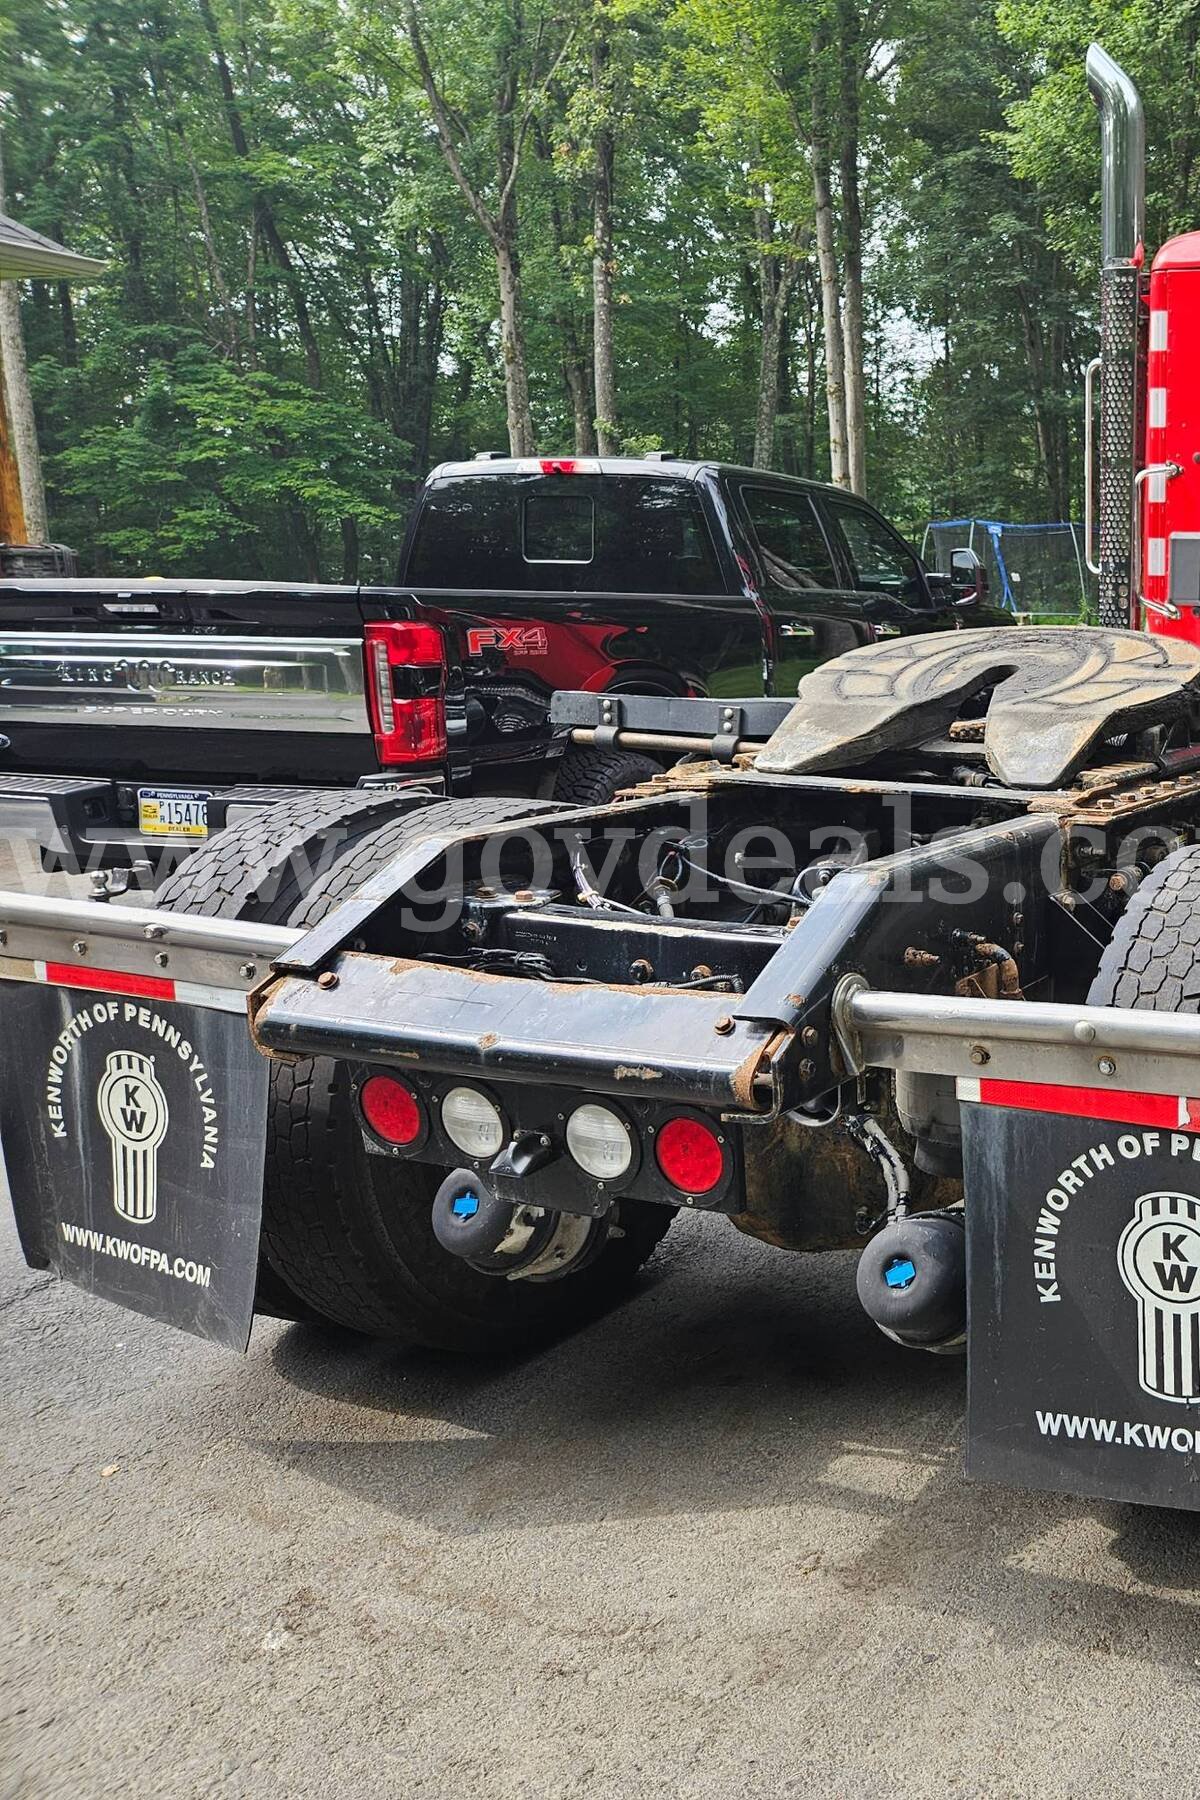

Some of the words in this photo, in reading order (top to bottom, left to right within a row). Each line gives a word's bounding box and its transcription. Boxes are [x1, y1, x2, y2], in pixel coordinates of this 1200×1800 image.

[56, 660, 112, 682] KING
[175, 669, 236, 686] RANCH
[467, 627, 548, 656] FX4
[46, 1009, 93, 1138] KENWORTH
[94, 1002, 119, 1023] OF
[124, 1002, 218, 1169] PENNSYLVANIA
[1032, 1143, 1115, 1304] KENWORTH
[1117, 1132, 1161, 1160] OF
[61, 1222, 211, 1287] WWW.KWOFPA.COM
